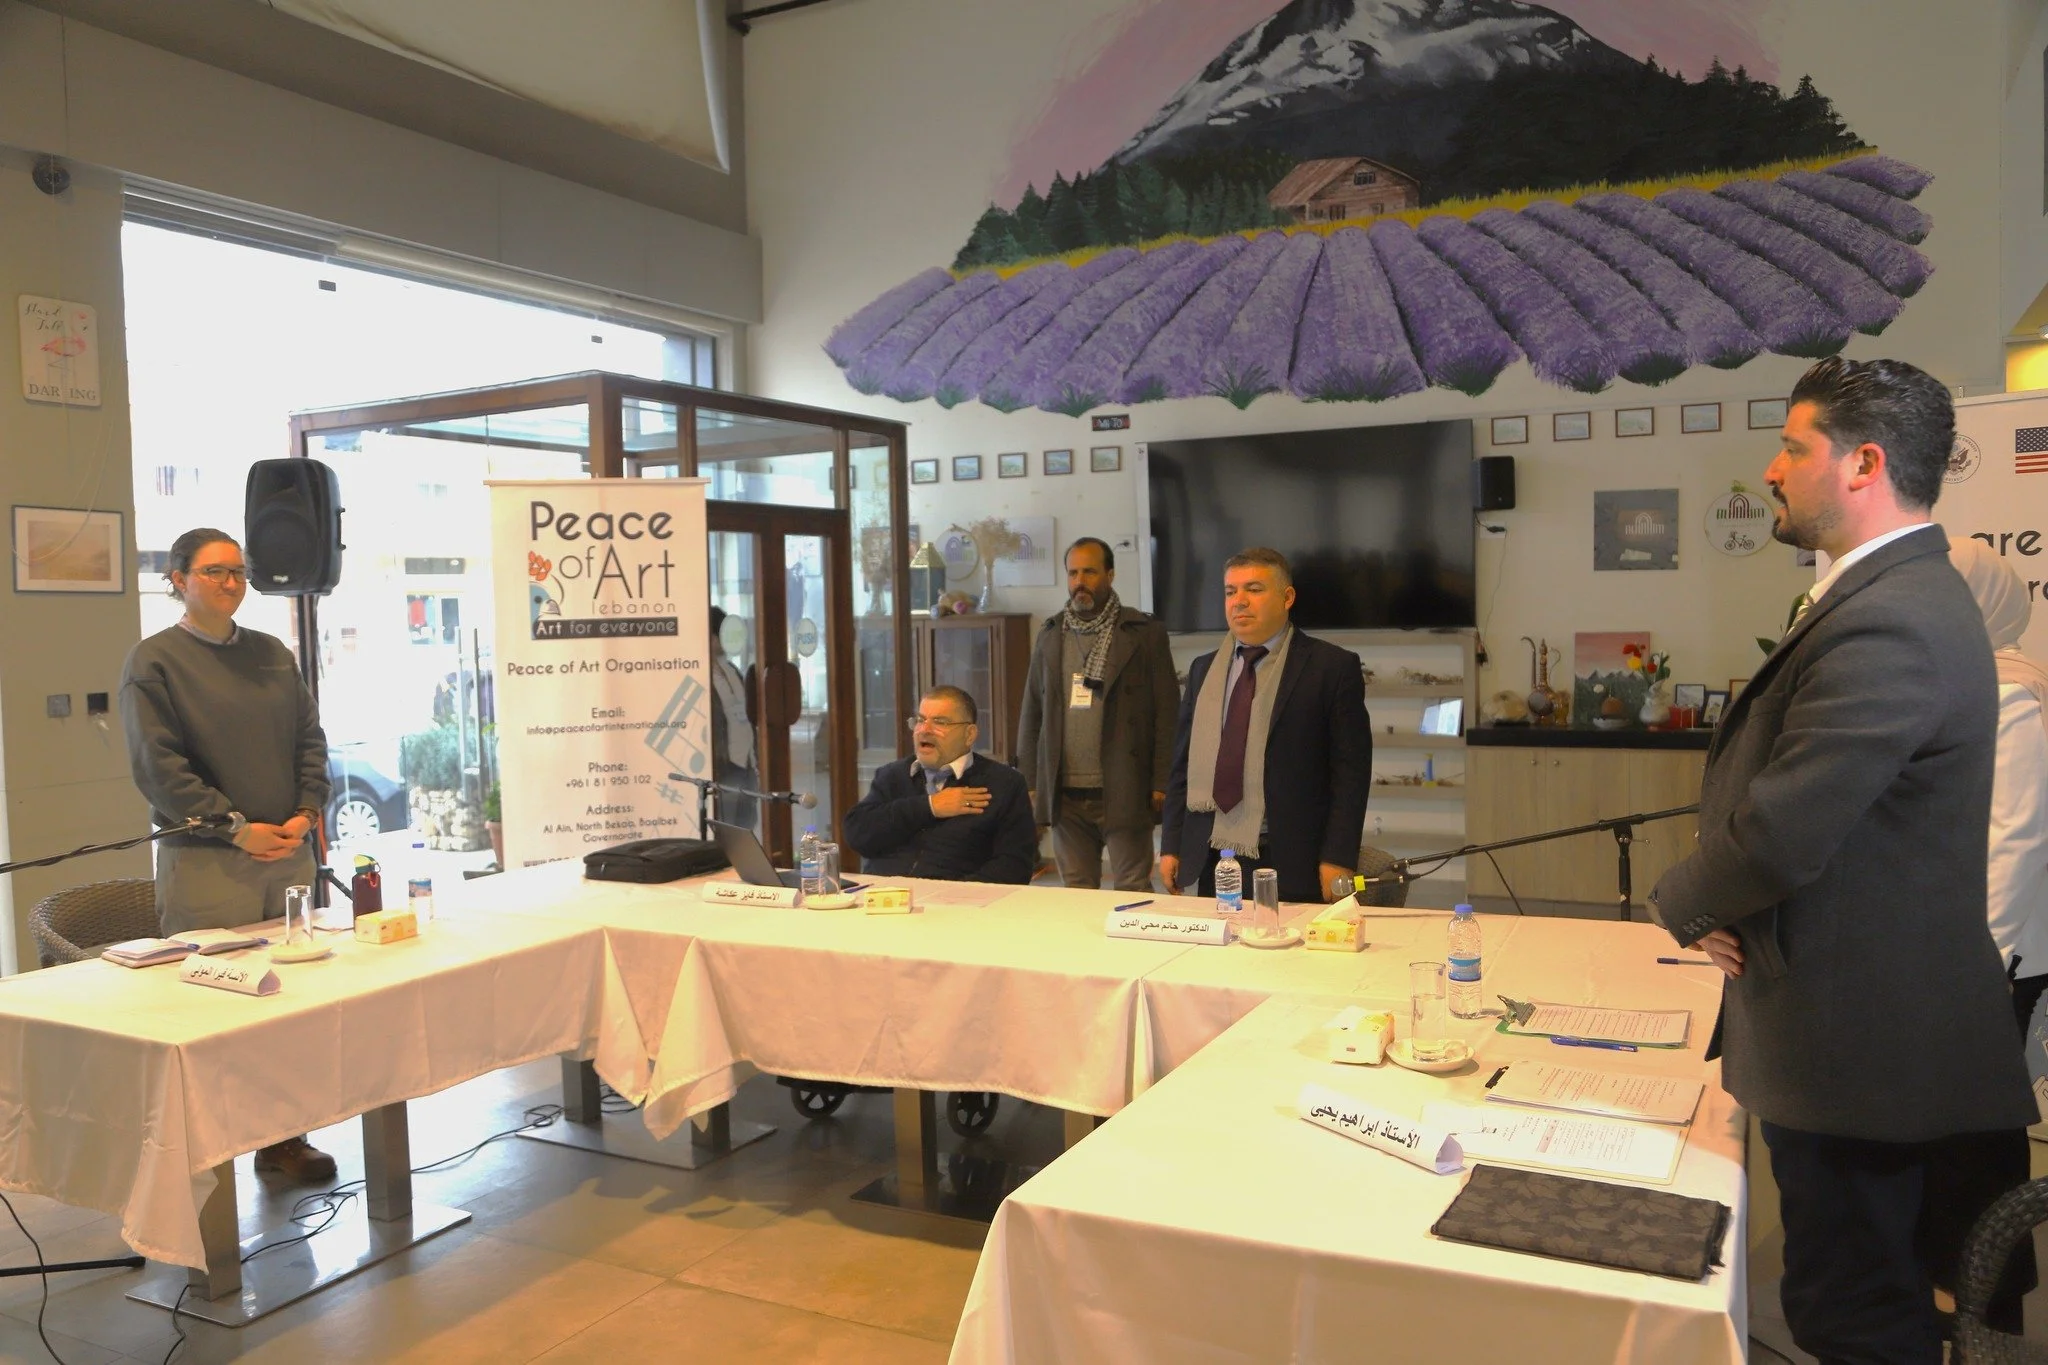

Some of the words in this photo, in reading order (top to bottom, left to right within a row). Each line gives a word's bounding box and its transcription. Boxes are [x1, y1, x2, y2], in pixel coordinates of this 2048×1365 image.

[530, 500, 674, 541] Peace
[559, 545, 596, 579] of
[593, 543, 675, 600] Art
[592, 601, 676, 615] lebanon
[536, 621, 562, 635] Art
[569, 620, 592, 634] for
[600, 620, 676, 635] everyone
[507, 662, 554, 676] Peace
[560, 660, 575, 674] of
[579, 660, 600, 672] Art
[605, 658, 700, 673] Organisation
[591, 707, 625, 719] Email:
[588, 762, 628, 773] Phone:
[566, 777, 589, 788] +961
[594, 777, 606, 787] 81
[610, 776, 629, 785] 950
[634, 775, 651, 784] 102
[586, 804, 634, 815] Address:
[576, 822, 602, 832] North
[582, 831, 643, 843] Governorate
[1120, 919, 1140, 928] الدين
[1181, 924, 1210, 933] الدكتور
[1310, 1105, 1339, 1122] يحيى
[1339, 1113, 1380, 1138] إبراهيم
